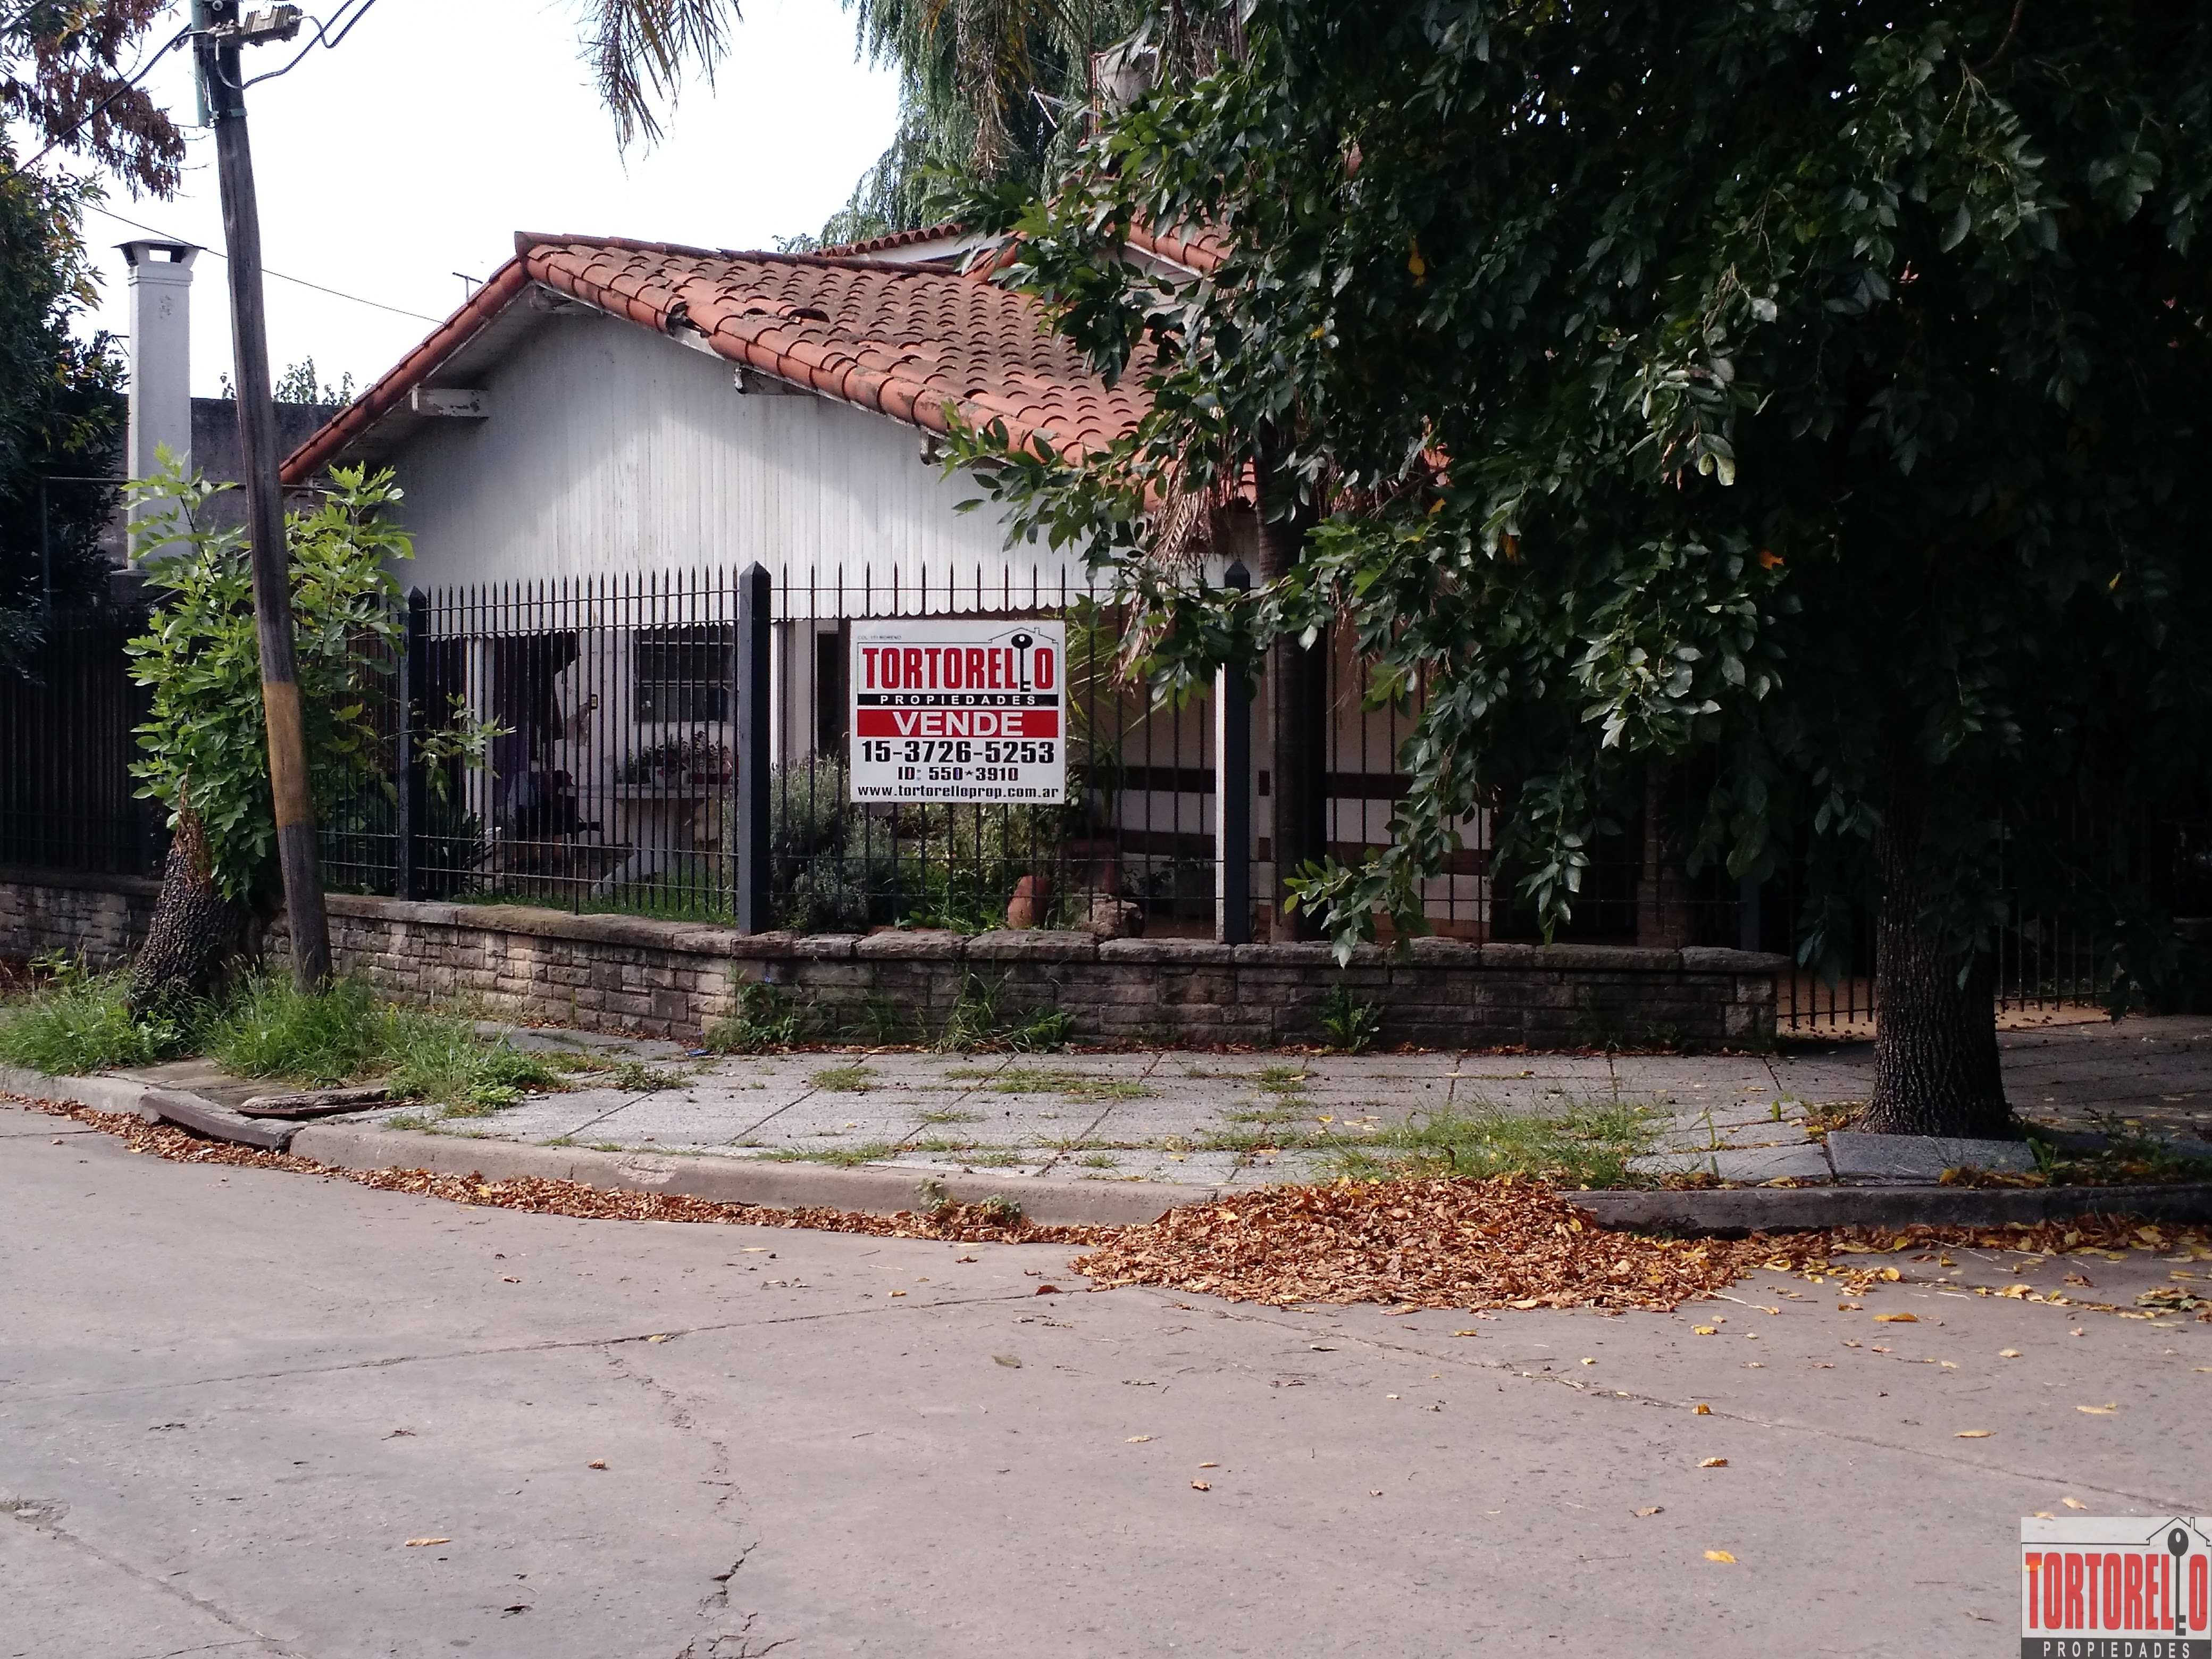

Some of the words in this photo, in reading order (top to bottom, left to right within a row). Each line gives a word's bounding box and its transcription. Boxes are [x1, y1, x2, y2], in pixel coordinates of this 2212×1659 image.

[862, 647, 1054, 691] TORTORELLO
[880, 696, 1036, 706] PROPIEDADES
[892, 711, 1024, 736] VENDE
[861, 740, 1055, 764] 15-3726-5253
[898, 767, 922, 781] ID:
[857, 785, 1059, 799] www.tortorelloprop.com.ar
